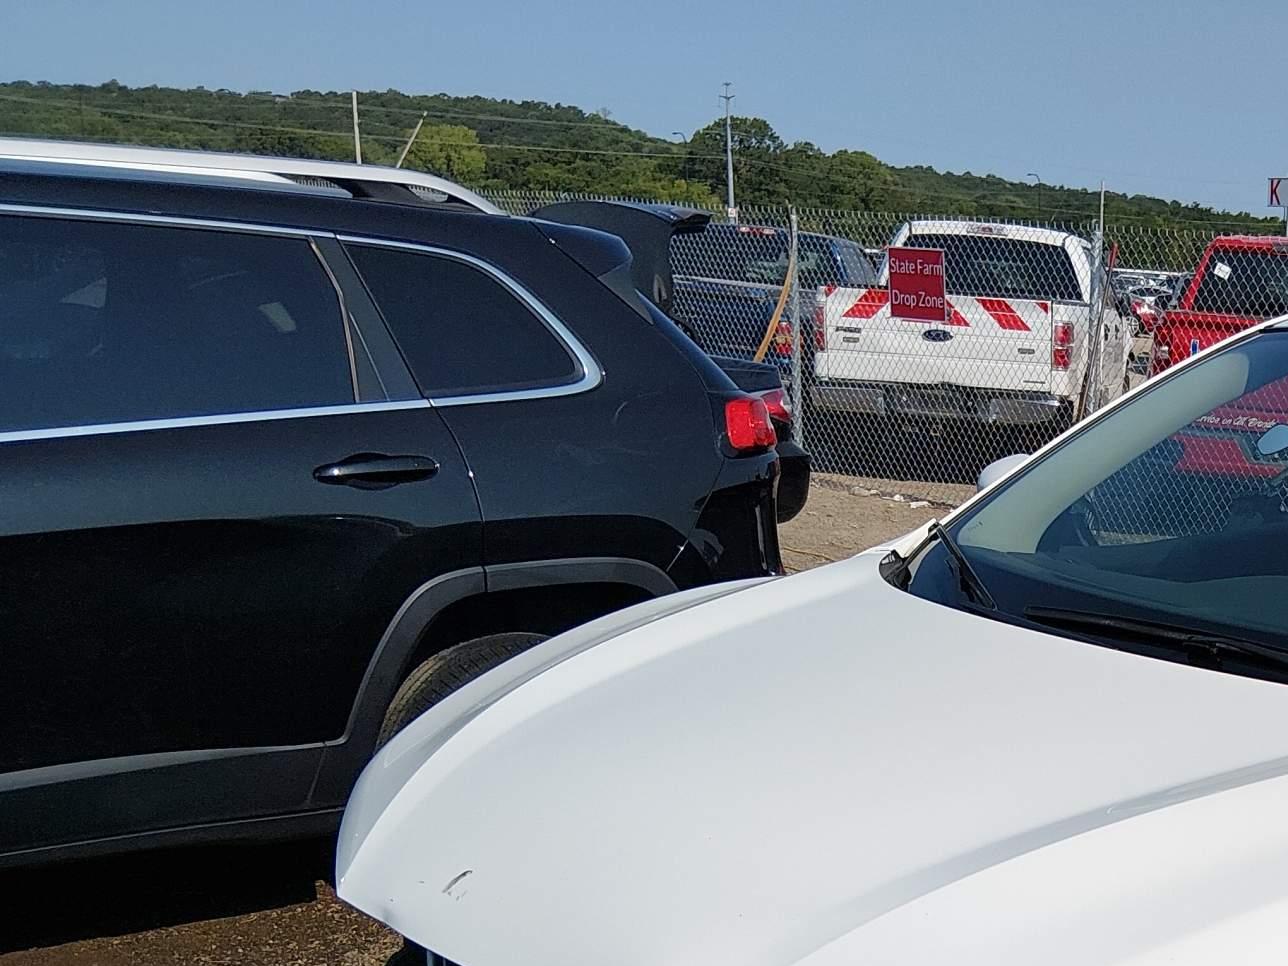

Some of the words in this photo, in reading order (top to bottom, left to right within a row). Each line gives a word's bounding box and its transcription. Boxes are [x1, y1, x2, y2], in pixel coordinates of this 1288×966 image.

[890, 257, 915, 274] State
[917, 259, 943, 276] Farm
[892, 289, 917, 309] Drop
[918, 291, 944, 309] Zone
